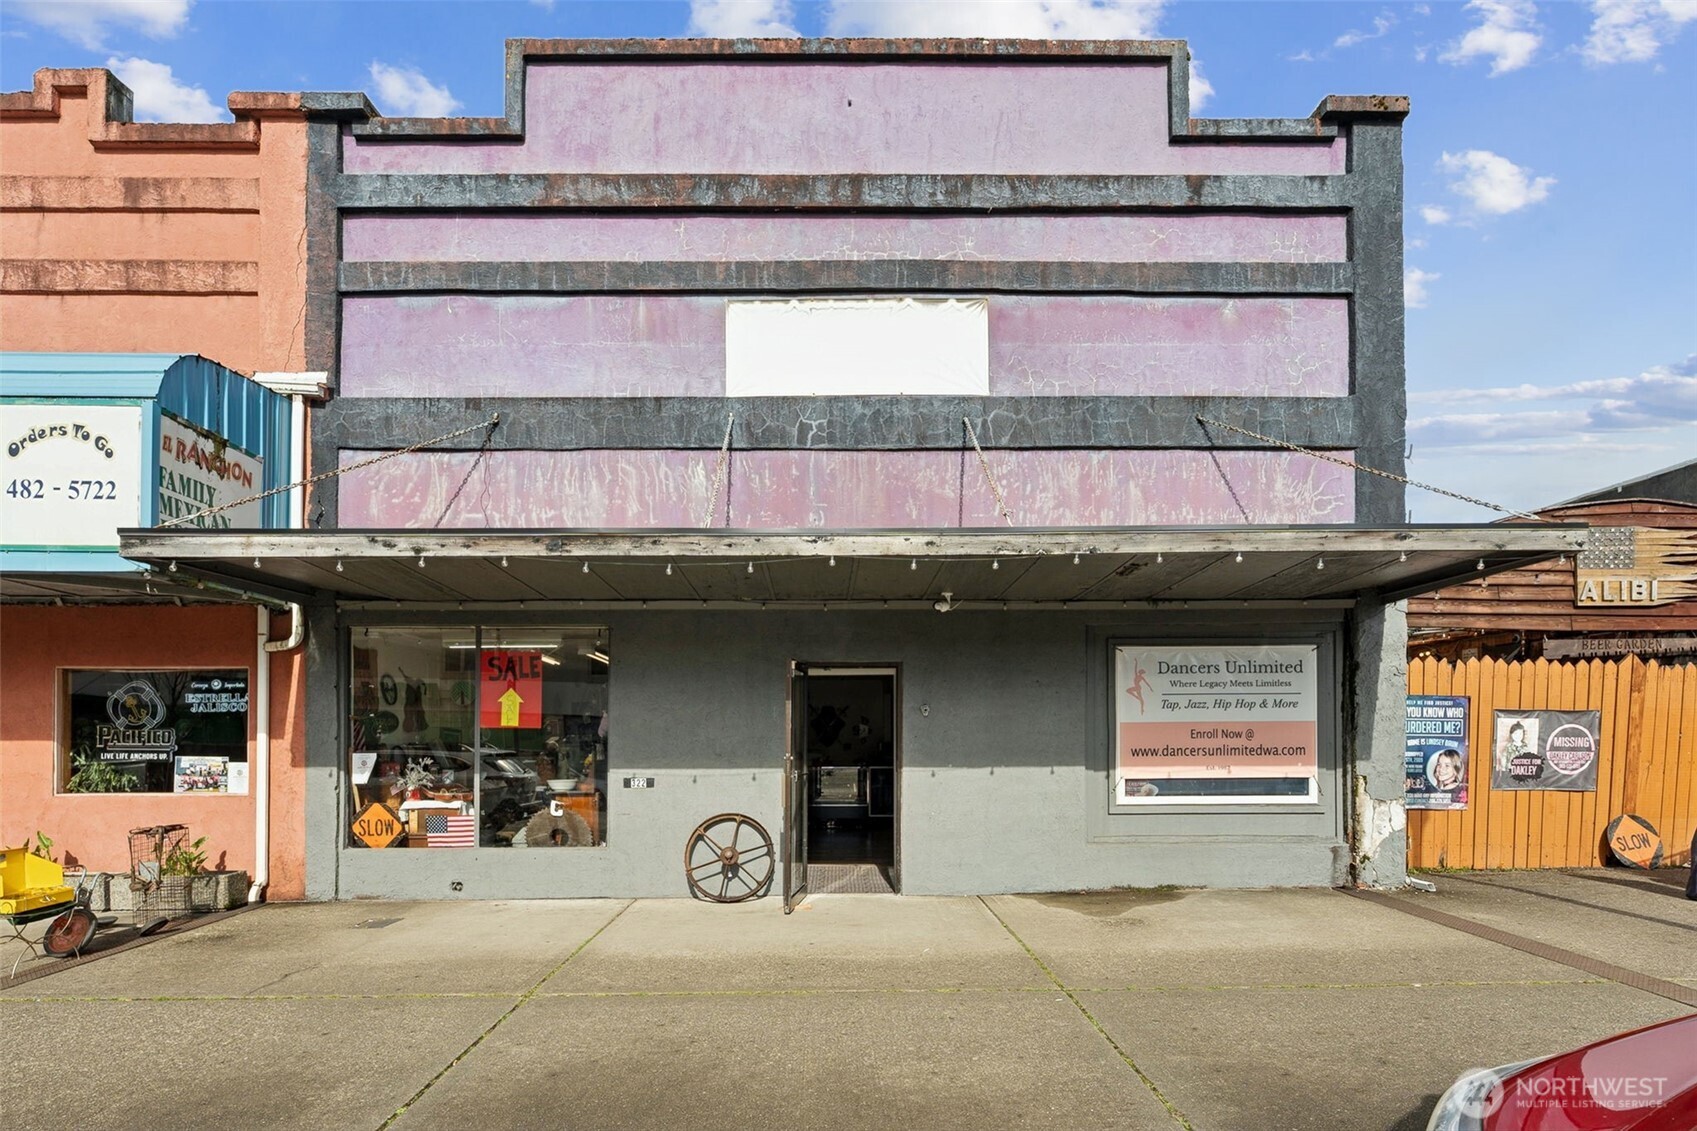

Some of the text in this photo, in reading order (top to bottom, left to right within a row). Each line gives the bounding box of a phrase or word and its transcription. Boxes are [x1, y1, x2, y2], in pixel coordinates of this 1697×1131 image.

[8, 423, 114, 459] Orders To Go
[162, 434, 172, 453] EL
[6, 478, 44, 499] 482
[68, 480, 117, 500] 5722
[160, 466, 216, 508] FAMILY
[1580, 580, 1658, 602] ALIBI
[1581, 638, 1662, 650] BEER GARDEN
[487, 656, 541, 681] SALE
[1157, 659, 1304, 675] Dancers Unlimited
[1169, 679, 1292, 689] Where Legacy Meets Limitless
[185, 693, 249, 703] ESTRELLA
[190, 702, 248, 713] JALISCO
[1161, 699, 1299, 711] Tap, Jazz, Hip Hop & More
[1406, 707, 1464, 718] YOU KNOW WHO
[1405, 721, 1461, 734] URDERED ME?
[1190, 729, 1255, 741] Enroll Now @
[1553, 736, 1590, 748] MISSING
[100, 752, 115, 760] LIVE
[116, 752, 129, 760] LIFE
[130, 752, 158, 760] ANCHORS
[1130, 744, 1306, 757] www.dancersunlimitedwa.com
[1511, 765, 1537, 776] OAKLEY
[631, 778, 646, 788] 322
[358, 819, 394, 837] SLOW
[1616, 833, 1652, 852] SLOW
